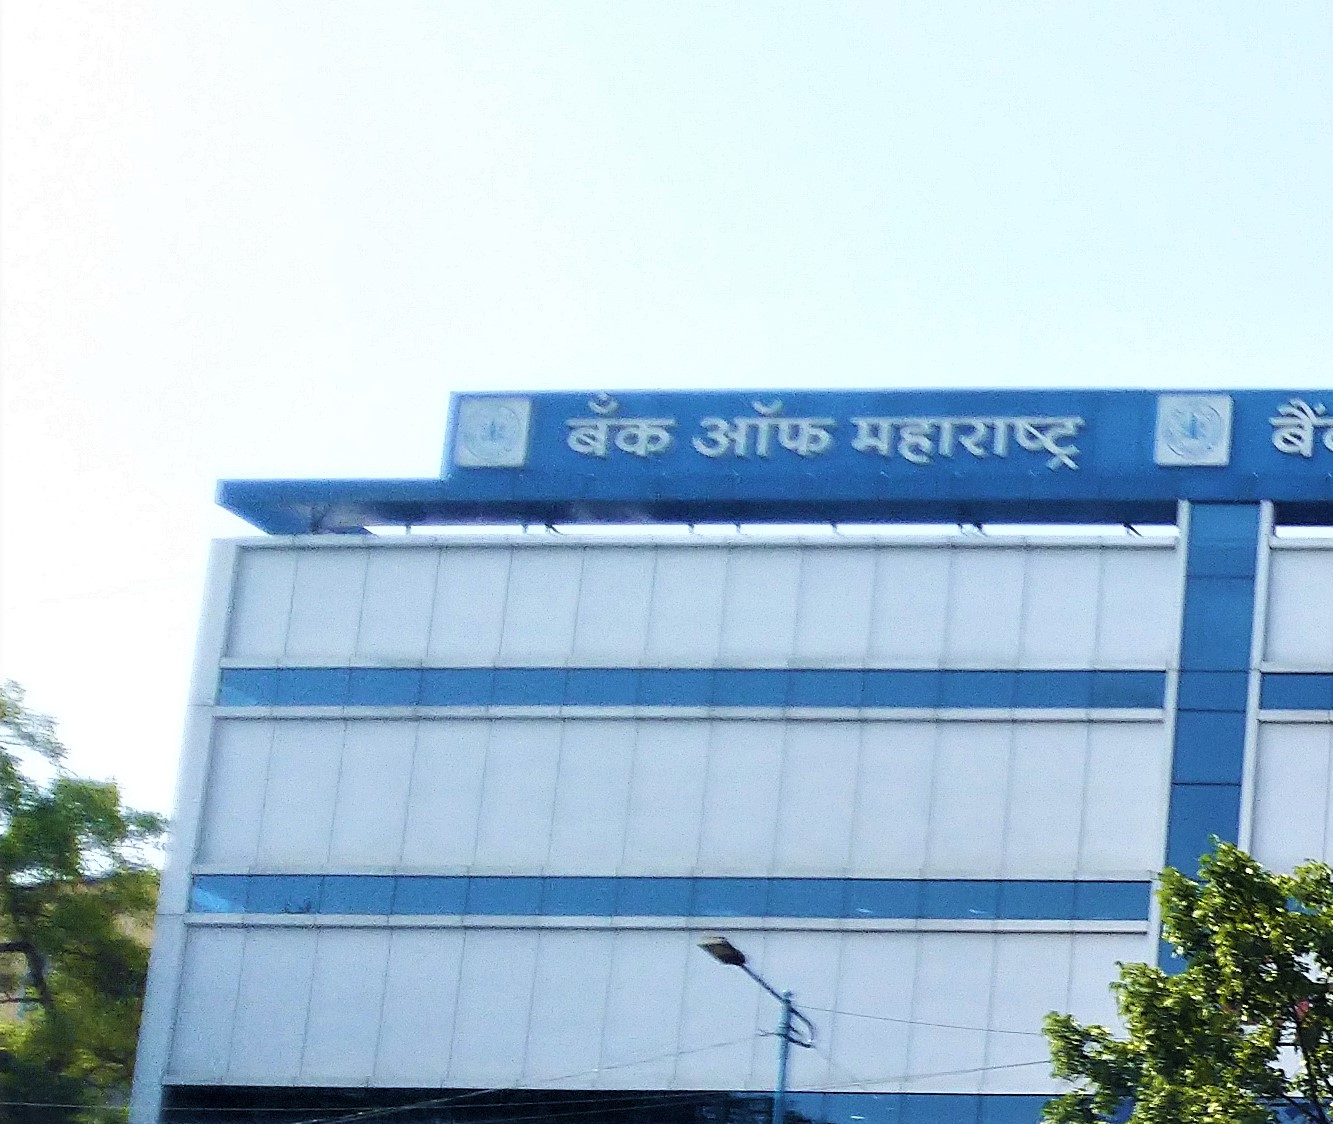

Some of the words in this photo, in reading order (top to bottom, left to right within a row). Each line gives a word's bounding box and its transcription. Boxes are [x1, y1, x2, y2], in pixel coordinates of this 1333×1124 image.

[566, 392, 676, 458] बँक
[692, 398, 835, 458] ऑफ
[851, 414, 1083, 470] महाराष्ट्र
